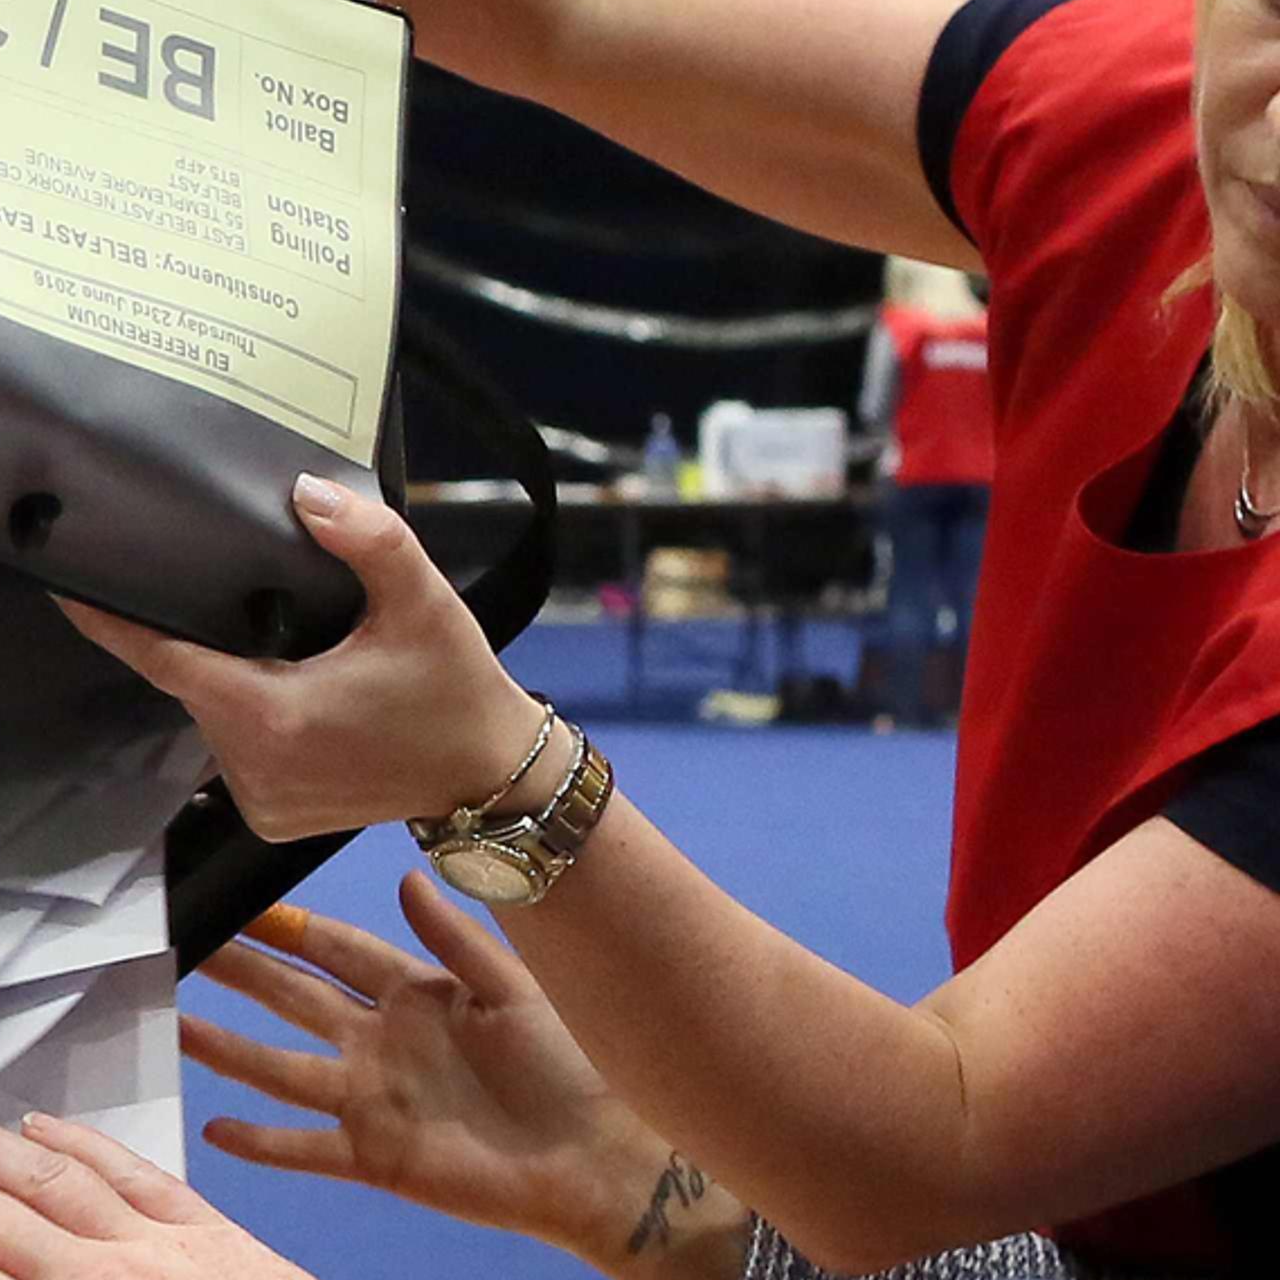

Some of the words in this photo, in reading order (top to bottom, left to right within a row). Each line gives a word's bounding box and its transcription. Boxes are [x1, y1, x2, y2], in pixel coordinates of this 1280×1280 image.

[97, 6, 217, 122] BE
[254, 72, 295, 106] No.
[302, 87, 350, 124] Box
[265, 109, 336, 154] Ballot
[25, 147, 96, 181] AVENUE
[209, 166, 241, 188] BT5
[28, 171, 116, 211] NETWORK
[101, 172, 220, 224] TEMPLEMORE
[168, 173, 243, 209] BELFAST
[123, 202, 197, 236] BELFAST
[225, 213, 244, 231] 55
[267, 194, 351, 242] Station
[42, 219, 148, 270] BELFAST
[203, 224, 246, 253] EAST
[270, 222, 352, 276] Polling
[33, 268, 77, 298] 2016
[81, 283, 124, 314] June
[154, 252, 300, 320] Constituency:
[131, 296, 172, 328] 23rd
[67, 303, 200, 362] REFERENDUM
[176, 311, 258, 359] Thursday
[205, 348, 231, 372] EU
